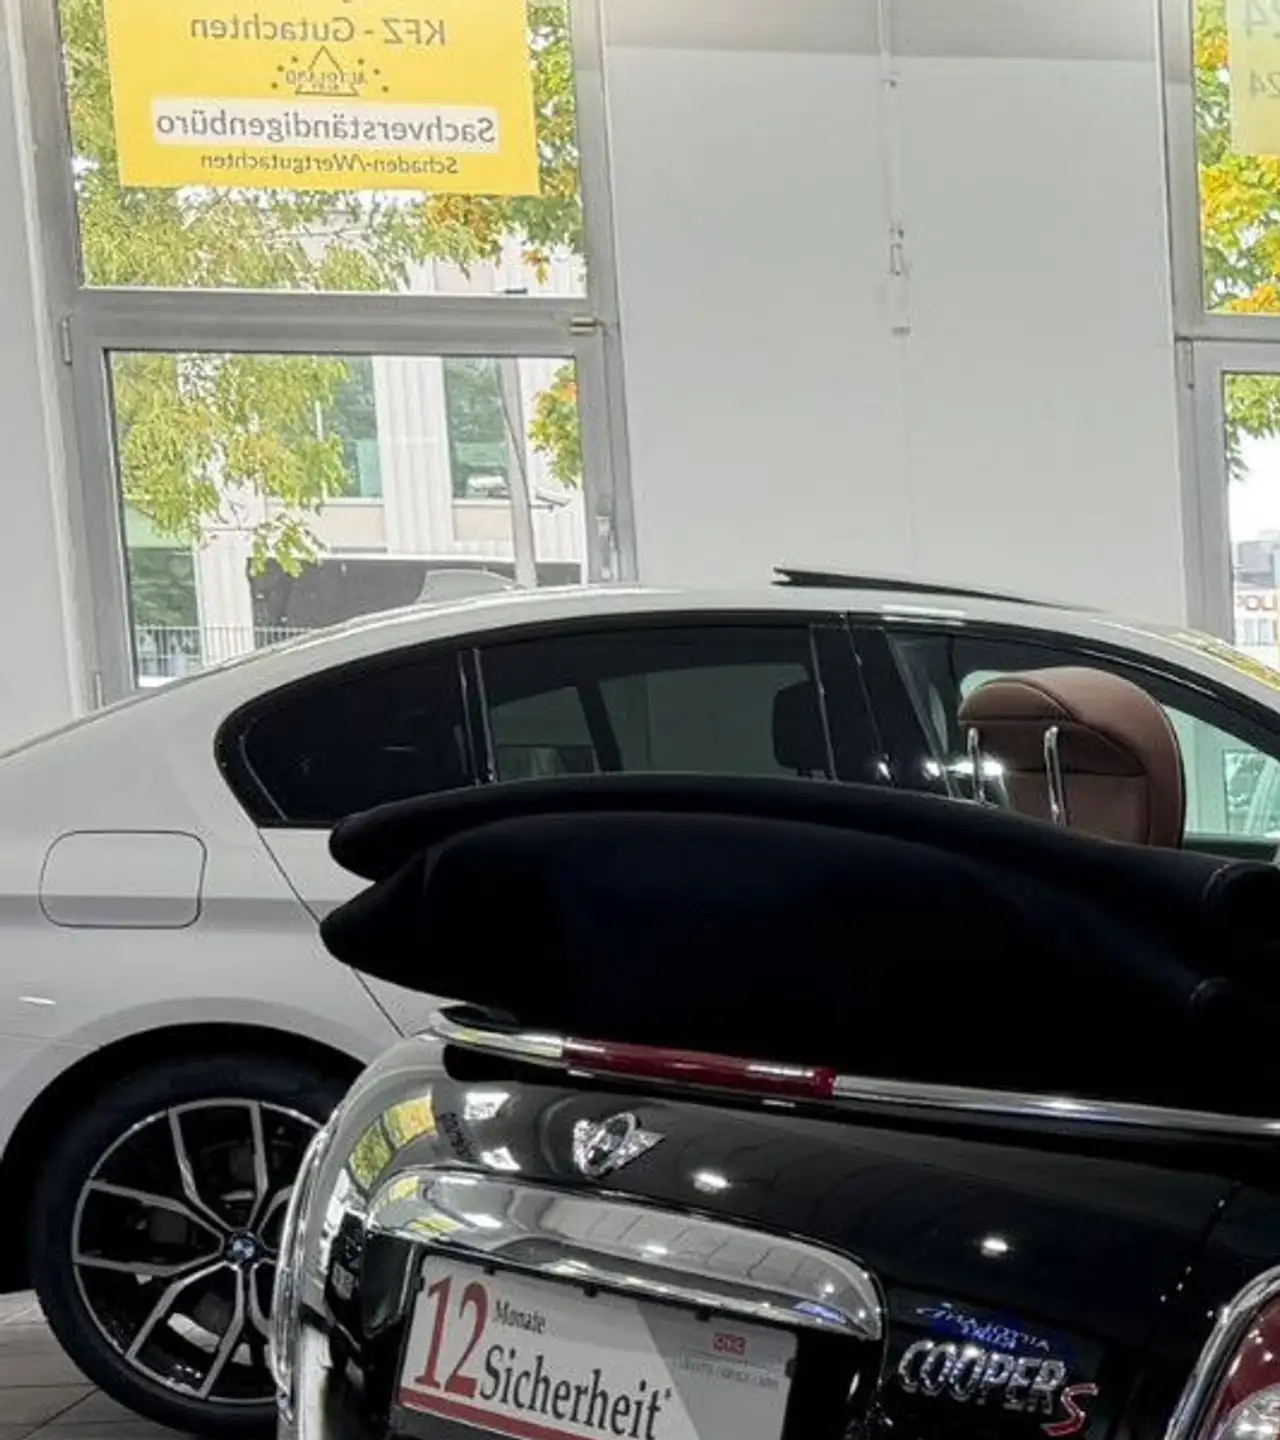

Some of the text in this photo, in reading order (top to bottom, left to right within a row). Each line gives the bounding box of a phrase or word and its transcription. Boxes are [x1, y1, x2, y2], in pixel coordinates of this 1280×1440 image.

[414, 1275, 546, 1399] 12 Monate
[897, 1339, 1100, 1437] COOPER S
